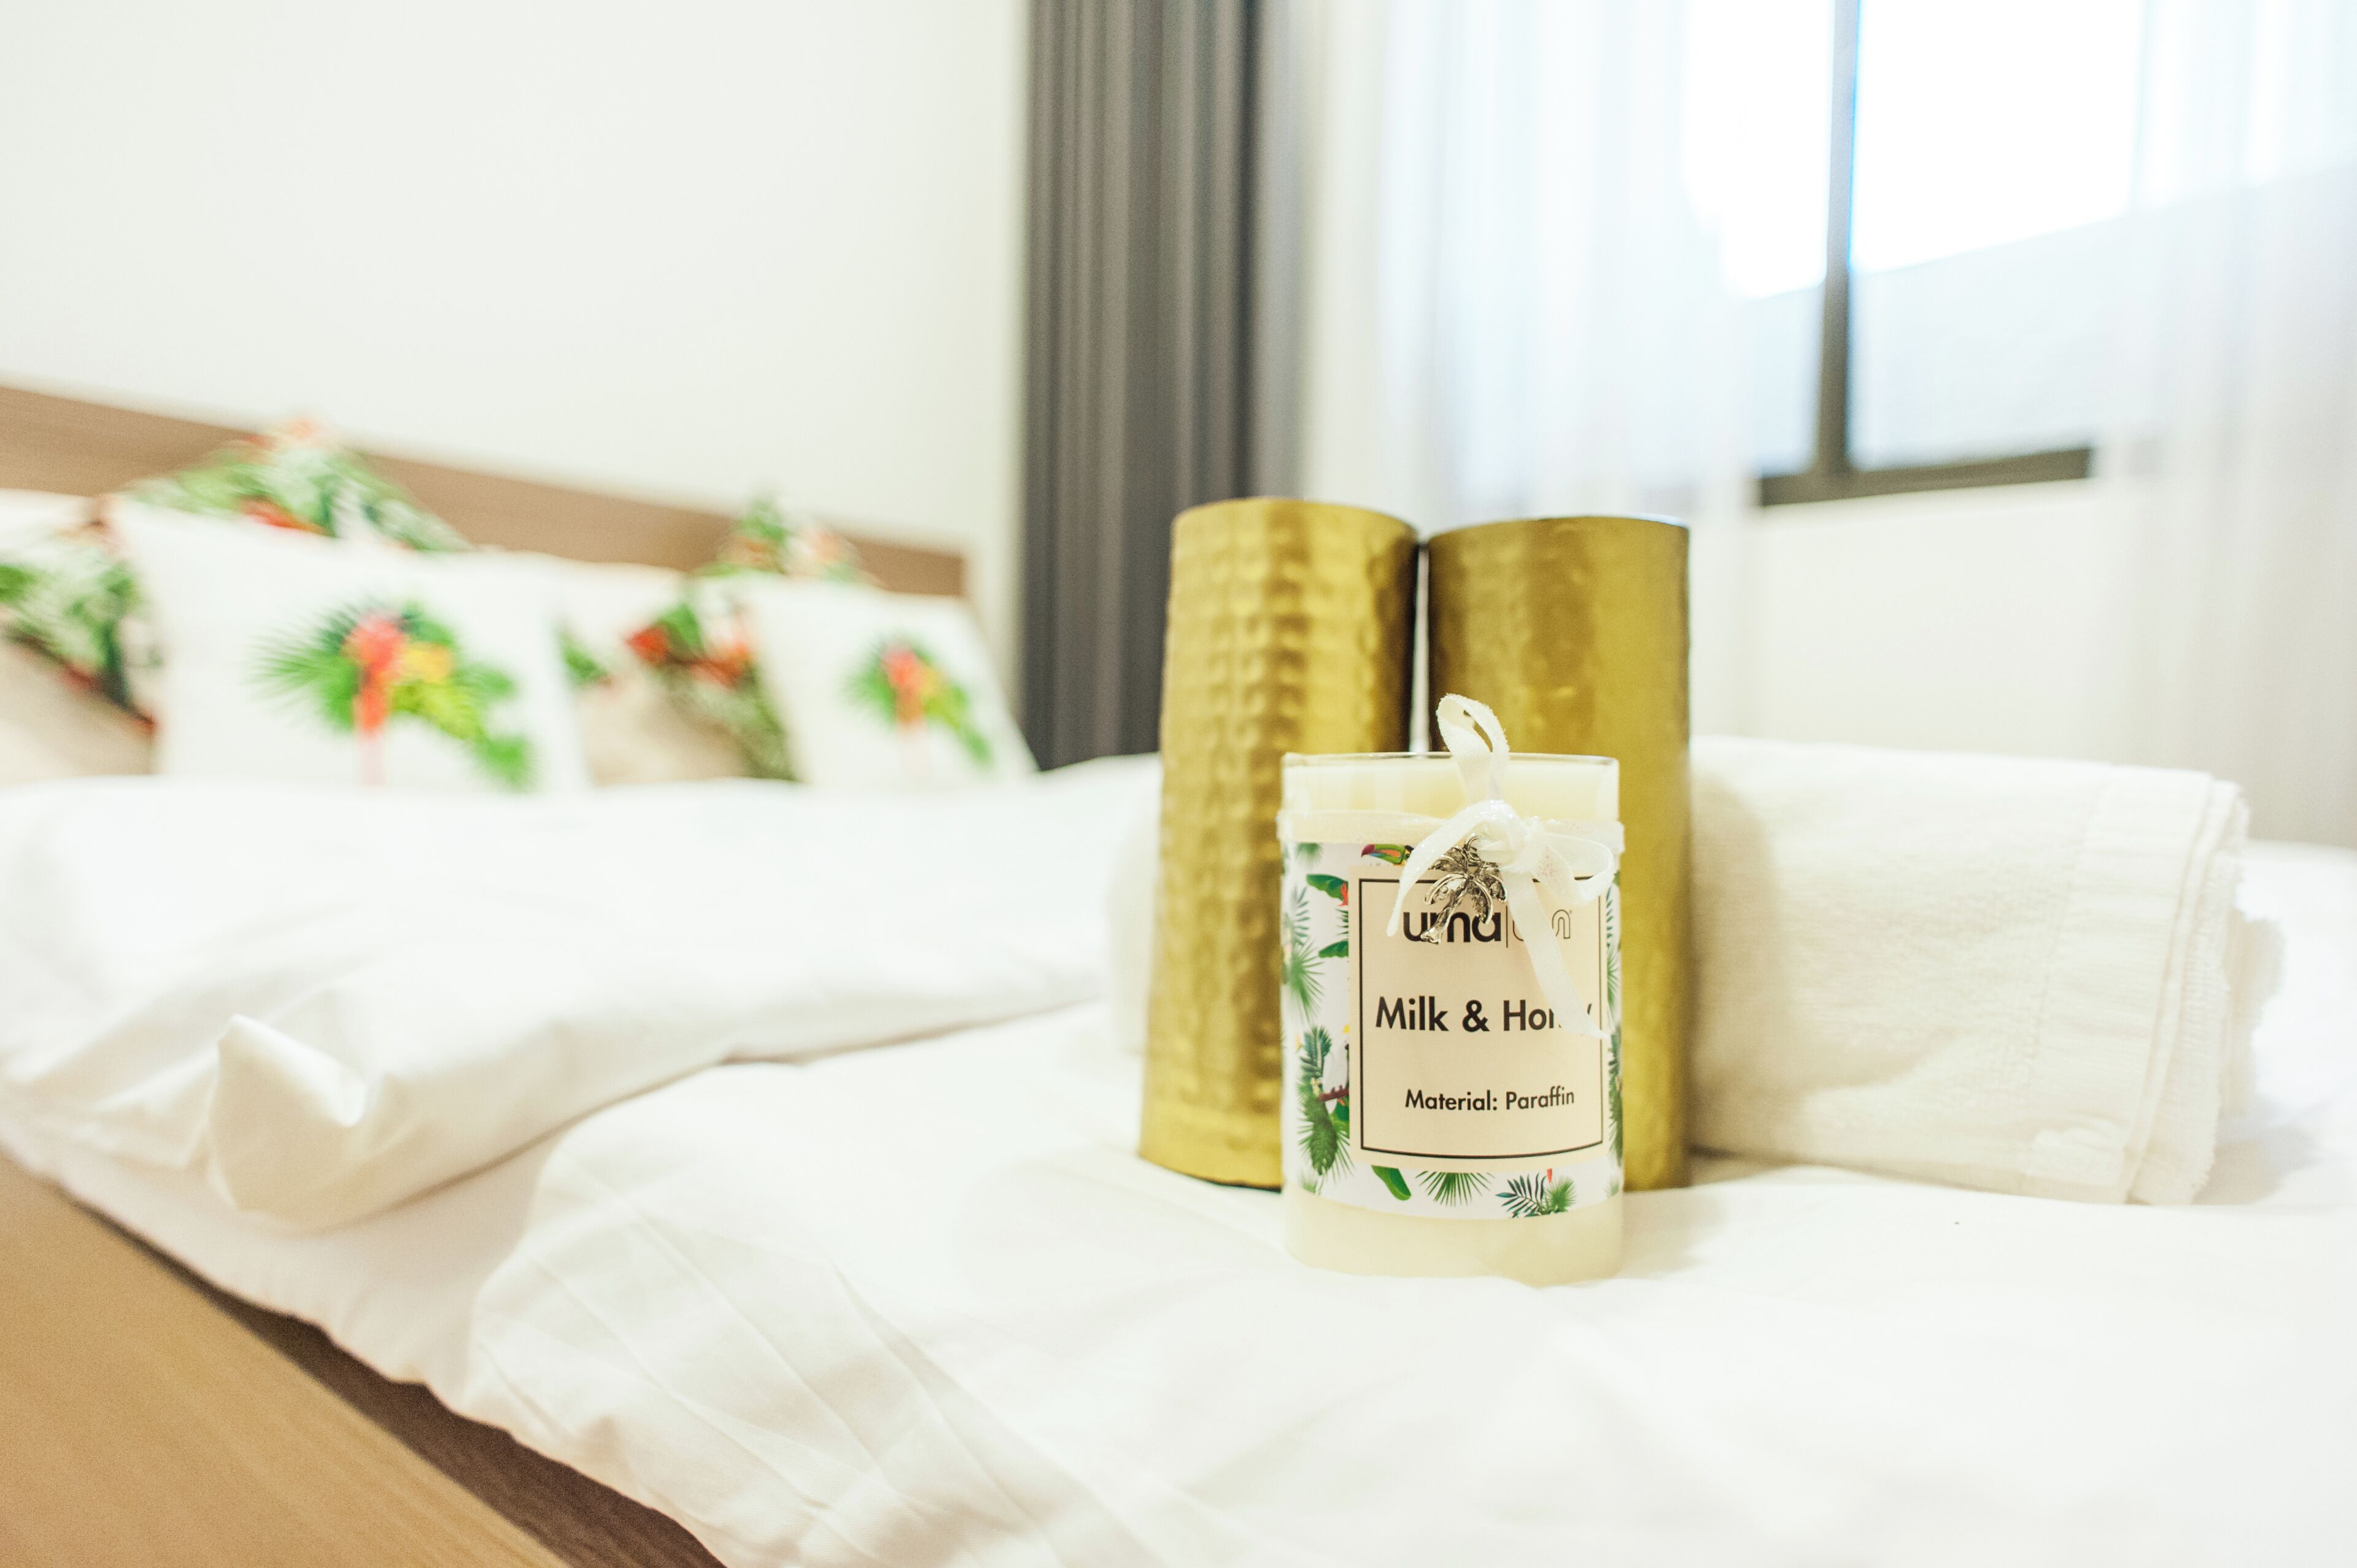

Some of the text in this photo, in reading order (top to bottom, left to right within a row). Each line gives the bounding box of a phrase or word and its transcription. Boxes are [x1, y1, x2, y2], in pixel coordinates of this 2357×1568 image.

[1375, 995, 1449, 1032] Milk
[1461, 999, 1490, 1032] &
[1405, 1085, 1574, 1111] Material: Paraffin
